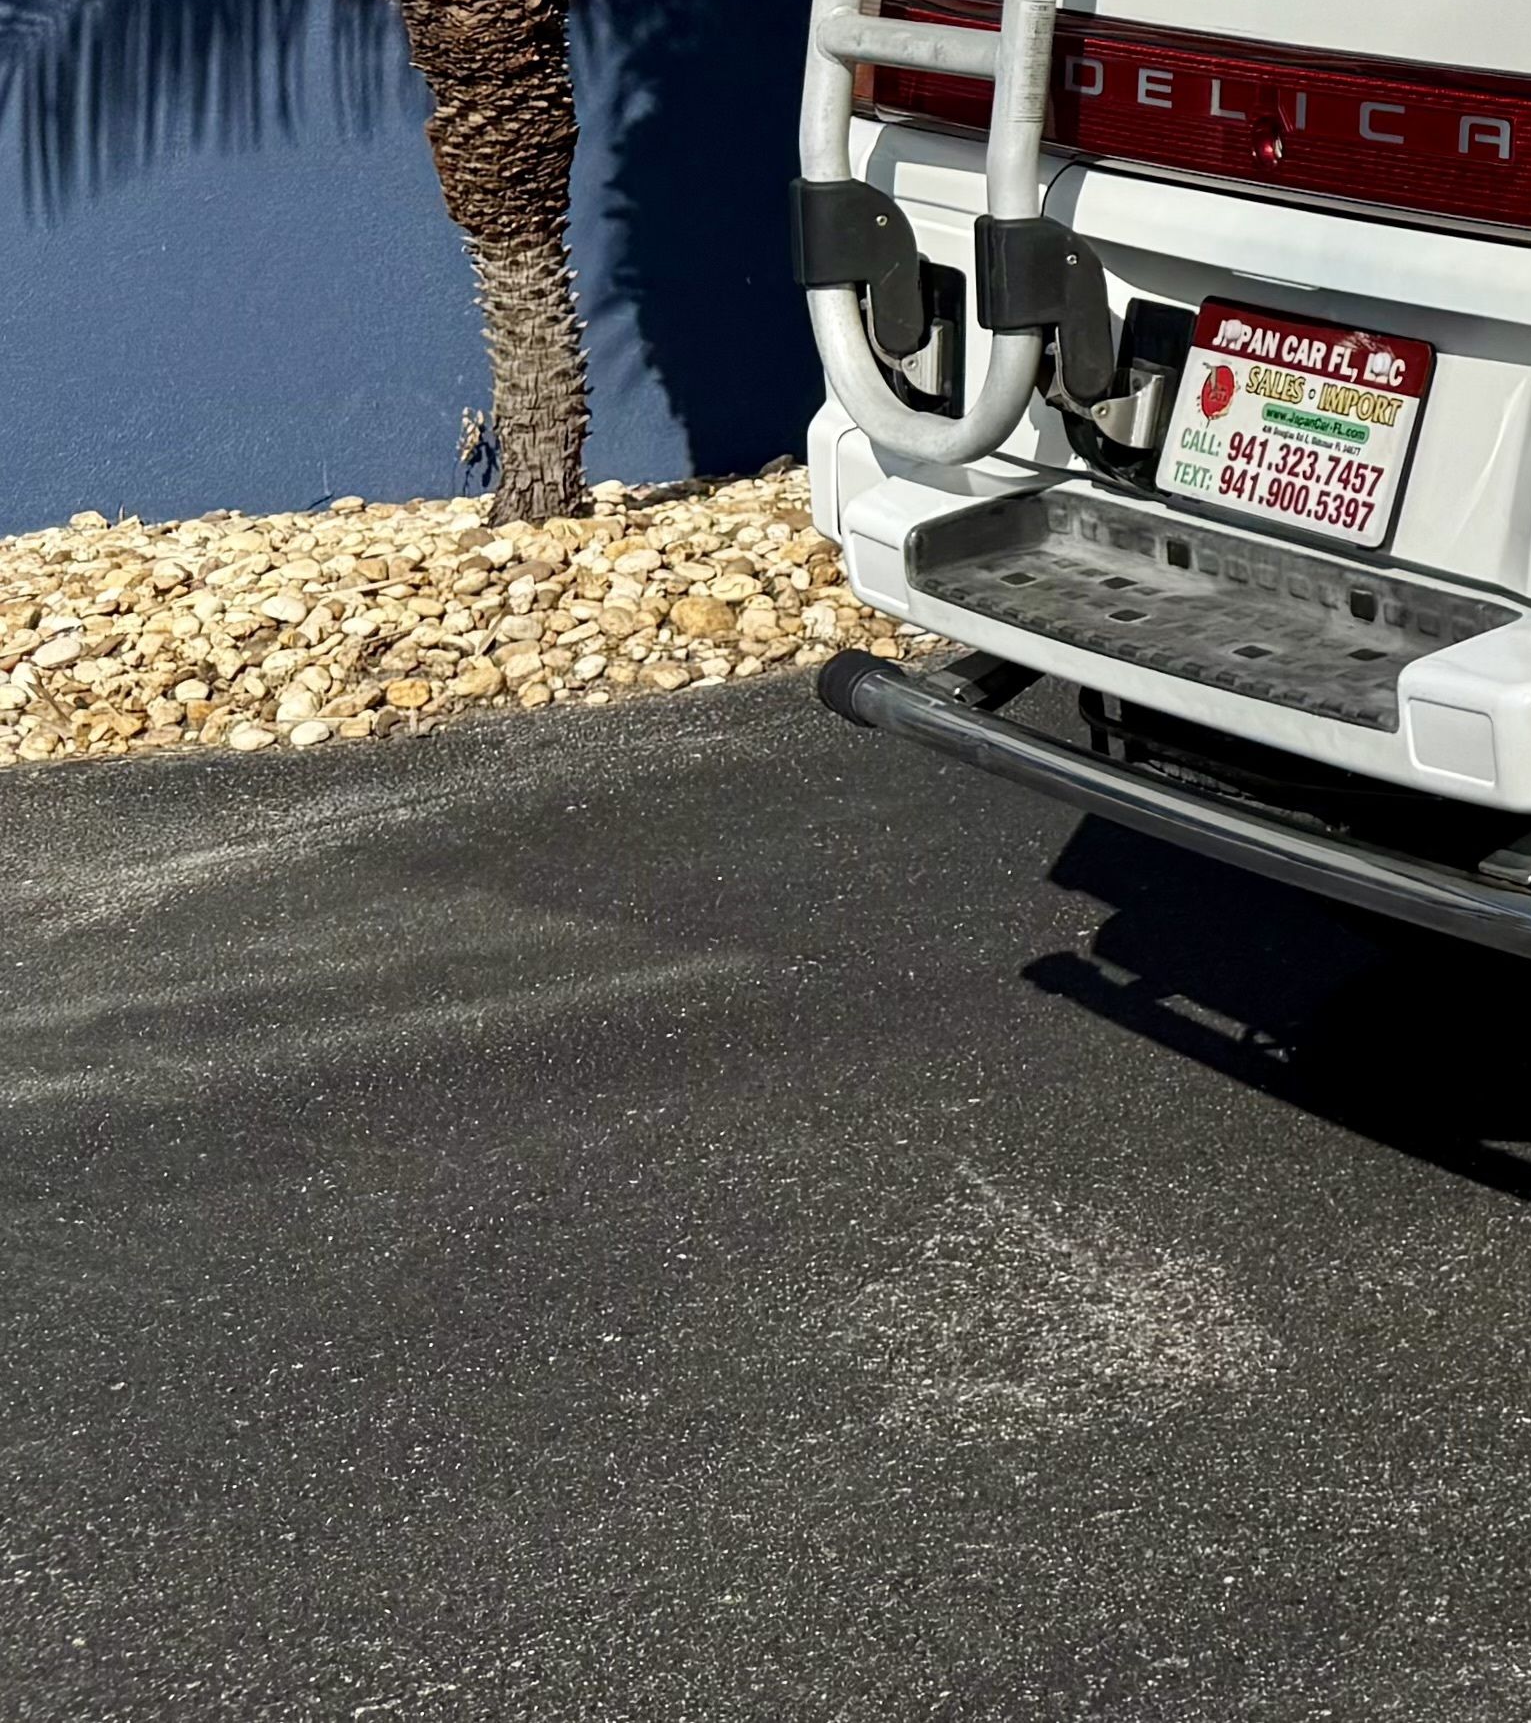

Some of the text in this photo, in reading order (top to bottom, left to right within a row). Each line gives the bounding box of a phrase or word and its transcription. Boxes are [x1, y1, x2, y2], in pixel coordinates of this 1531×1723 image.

[1066, 54, 1514, 162] DELICA
[1246, 366, 1403, 427] SALES IMPORT
[1281, 335, 1326, 369] CAR
[1329, 346, 1359, 382] FL,
[1363, 353, 1406, 387] LC
[1173, 460, 1376, 533] TEXT: 941.900.5397
[1180, 427, 1385, 499] CALL: 941.323.7457
